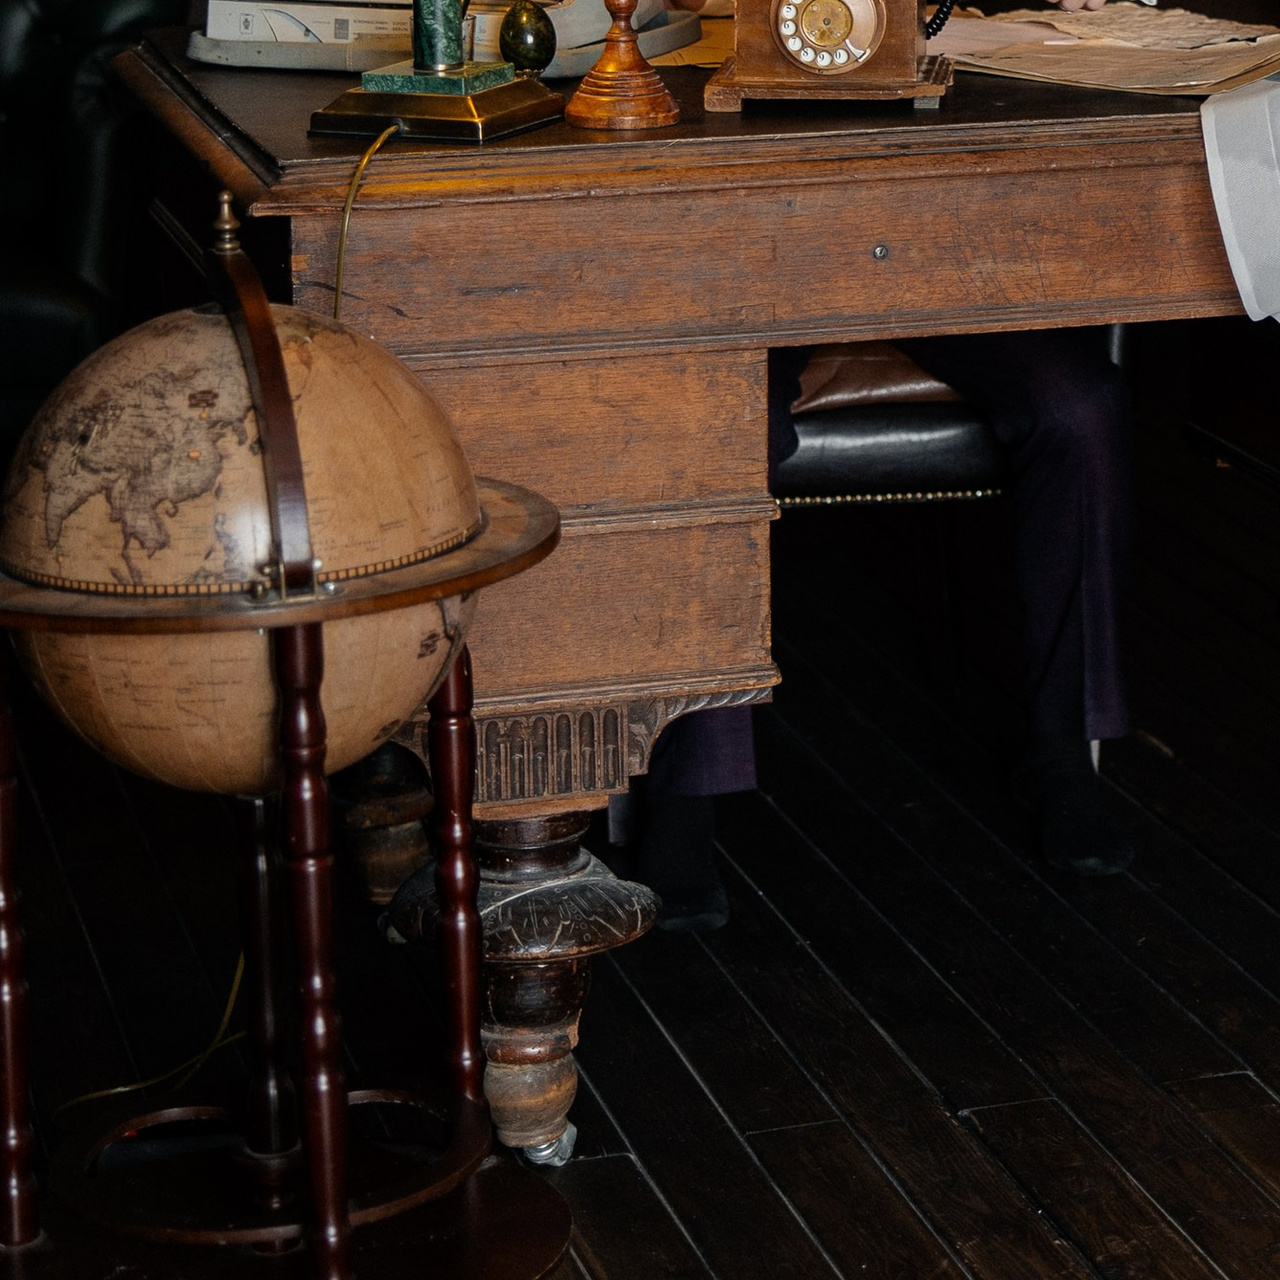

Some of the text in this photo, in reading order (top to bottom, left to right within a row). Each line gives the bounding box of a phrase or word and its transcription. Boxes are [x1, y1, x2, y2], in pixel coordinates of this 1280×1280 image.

[786, 4, 792, 13] 5
[791, 37, 797, 46] 7
[802, 48, 809, 57] 8
[835, 51, 841, 59] 0
